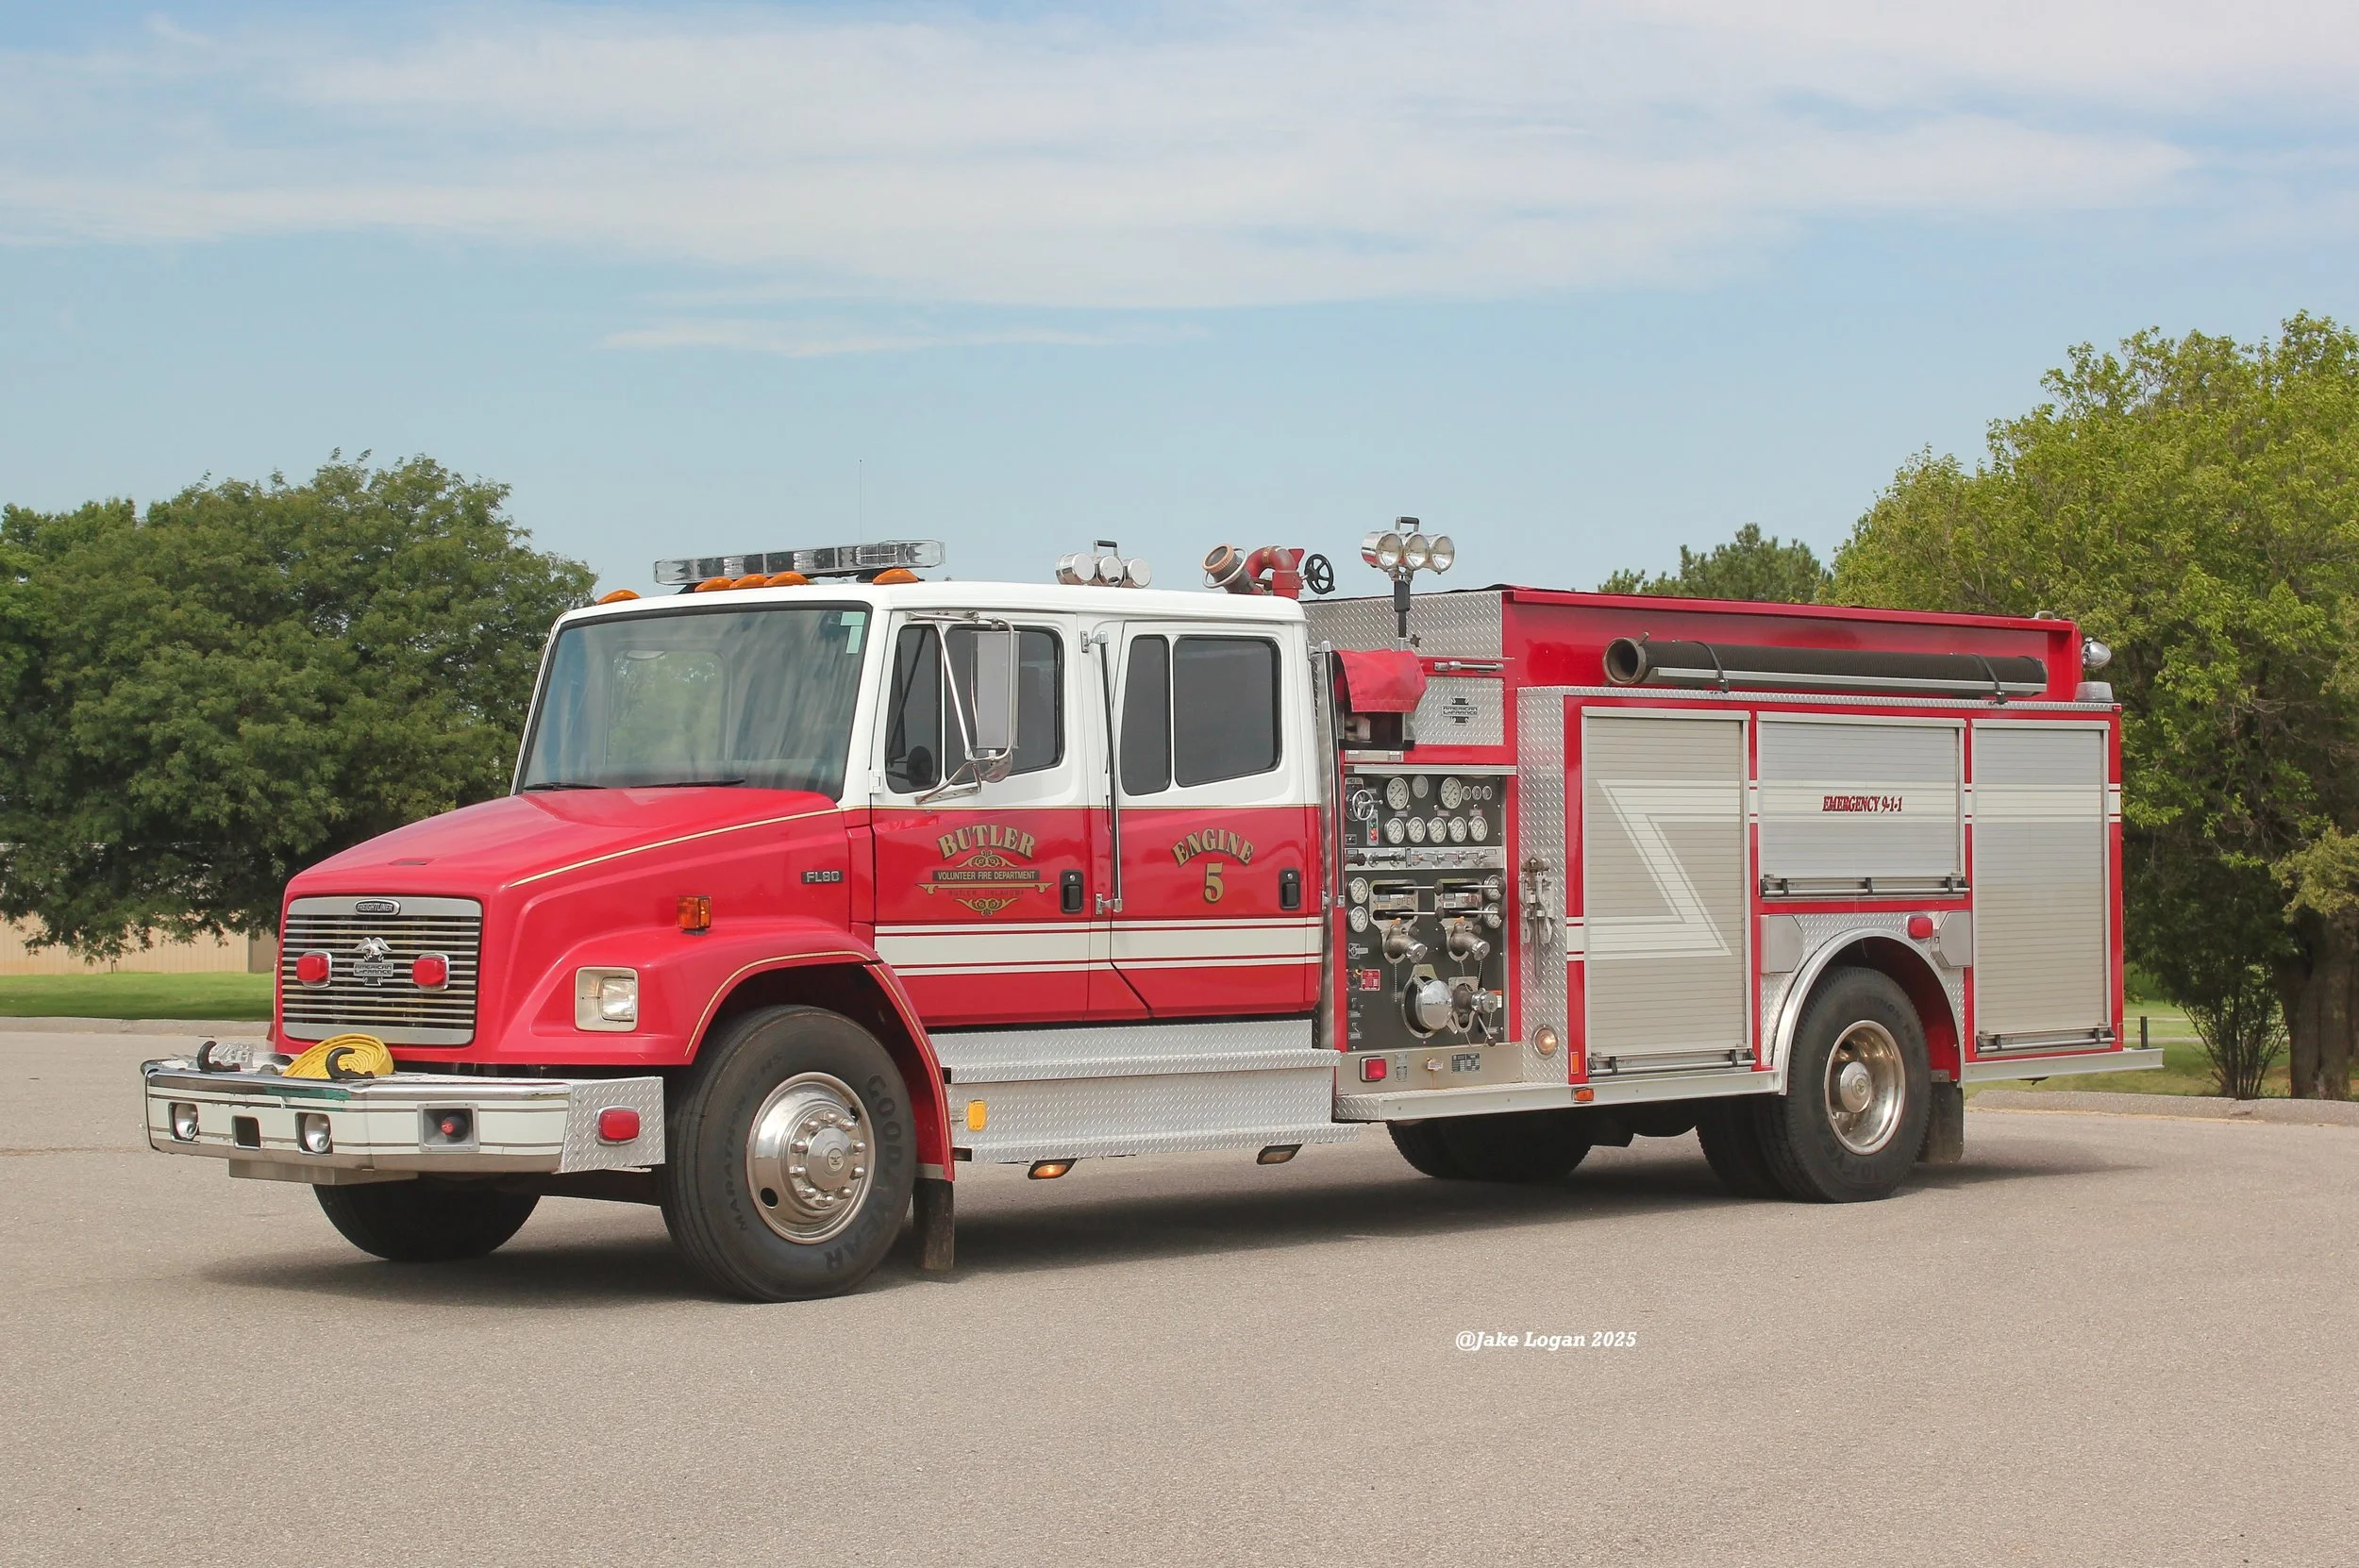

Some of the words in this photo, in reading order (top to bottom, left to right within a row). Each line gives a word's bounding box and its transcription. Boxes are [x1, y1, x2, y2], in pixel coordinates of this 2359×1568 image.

[1822, 795, 1881, 812] EMERGENCY
[1881, 795, 1903, 814] 9-1-1
[937, 824, 1035, 859] BUTLER
[1171, 828, 1254, 868] ENGINE
[938, 871, 976, 880] VOLUNTEER
[978, 871, 992, 880] FIRE
[994, 870, 1035, 880] DEPARTMENT
[1203, 861, 1225, 905] 5
[358, 903, 393, 911] FREIGHTLINER
[1397, 897, 1415, 906] OPEN
